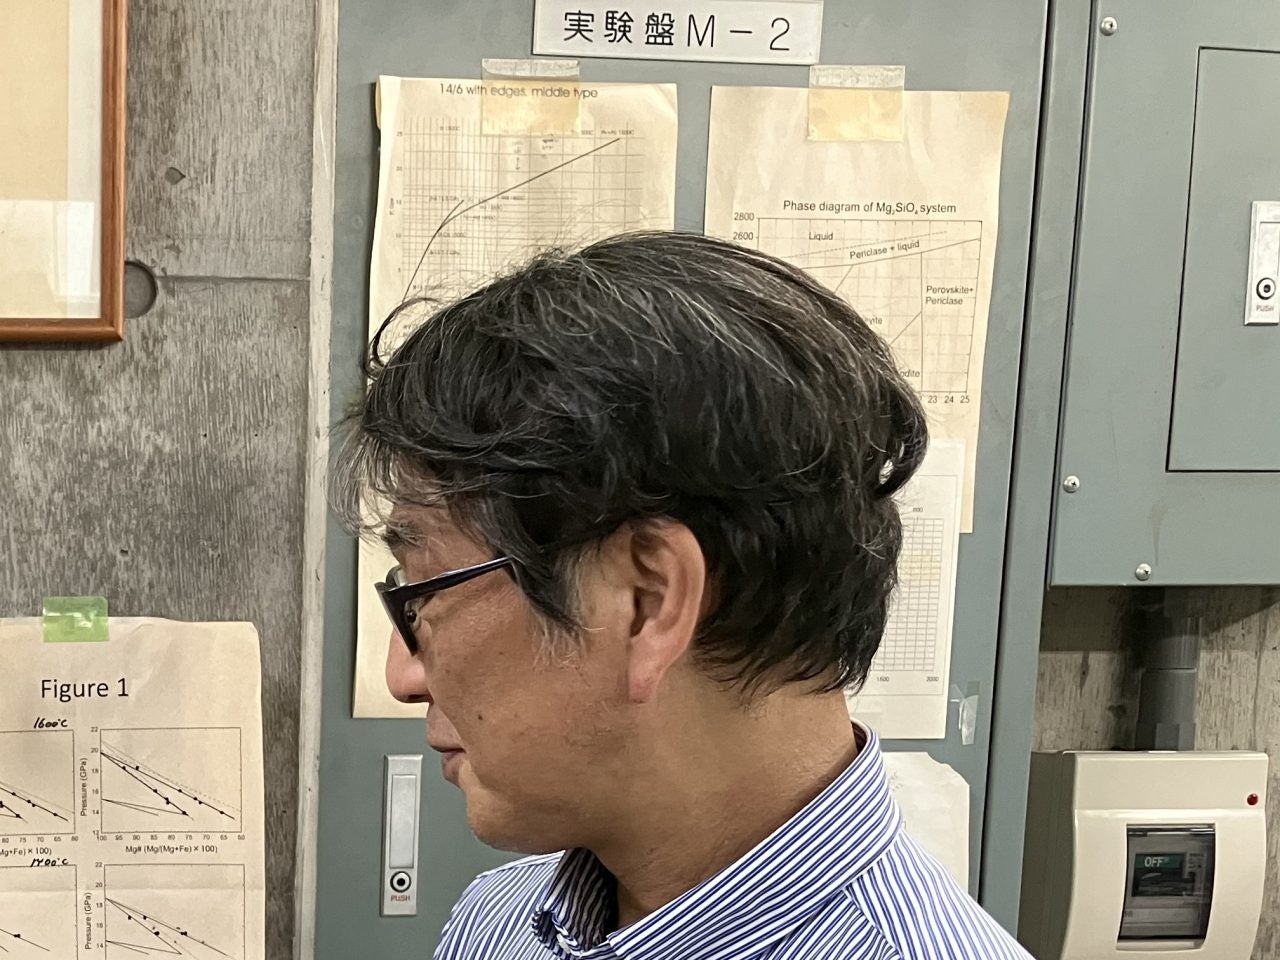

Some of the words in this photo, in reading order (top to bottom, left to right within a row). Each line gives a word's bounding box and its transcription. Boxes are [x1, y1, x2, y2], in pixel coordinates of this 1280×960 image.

[439, 82, 463, 96] 14/6
[465, 84, 487, 96] with
[531, 86, 570, 98] middle
[574, 87, 598, 101] type
[783, 199, 816, 211] Phase
[819, 201, 860, 214] diagram
[863, 201, 874, 212] of
[919, 203, 957, 215] system
[733, 211, 755, 221] 2800
[732, 231, 754, 241] 2600
[808, 231, 834, 242] Liquid
[849, 244, 888, 260] Periclase
[896, 239, 920, 252] liquid
[926, 284, 974, 296] Perovskite+
[925, 296, 963, 306] Periclase
[927, 395, 938, 404] 23
[944, 395, 954, 404] 24
[960, 395, 970, 404] 25
[41, 679, 109, 703] Figure
[117, 677, 129, 697] 1
[80, 757, 88, 781] (GPa)
[35, 847, 52, 855] 100)
[201, 845, 218, 853] 100)
[1144, 856, 1163, 867] OFF
[85, 892, 93, 915] (GPa)
